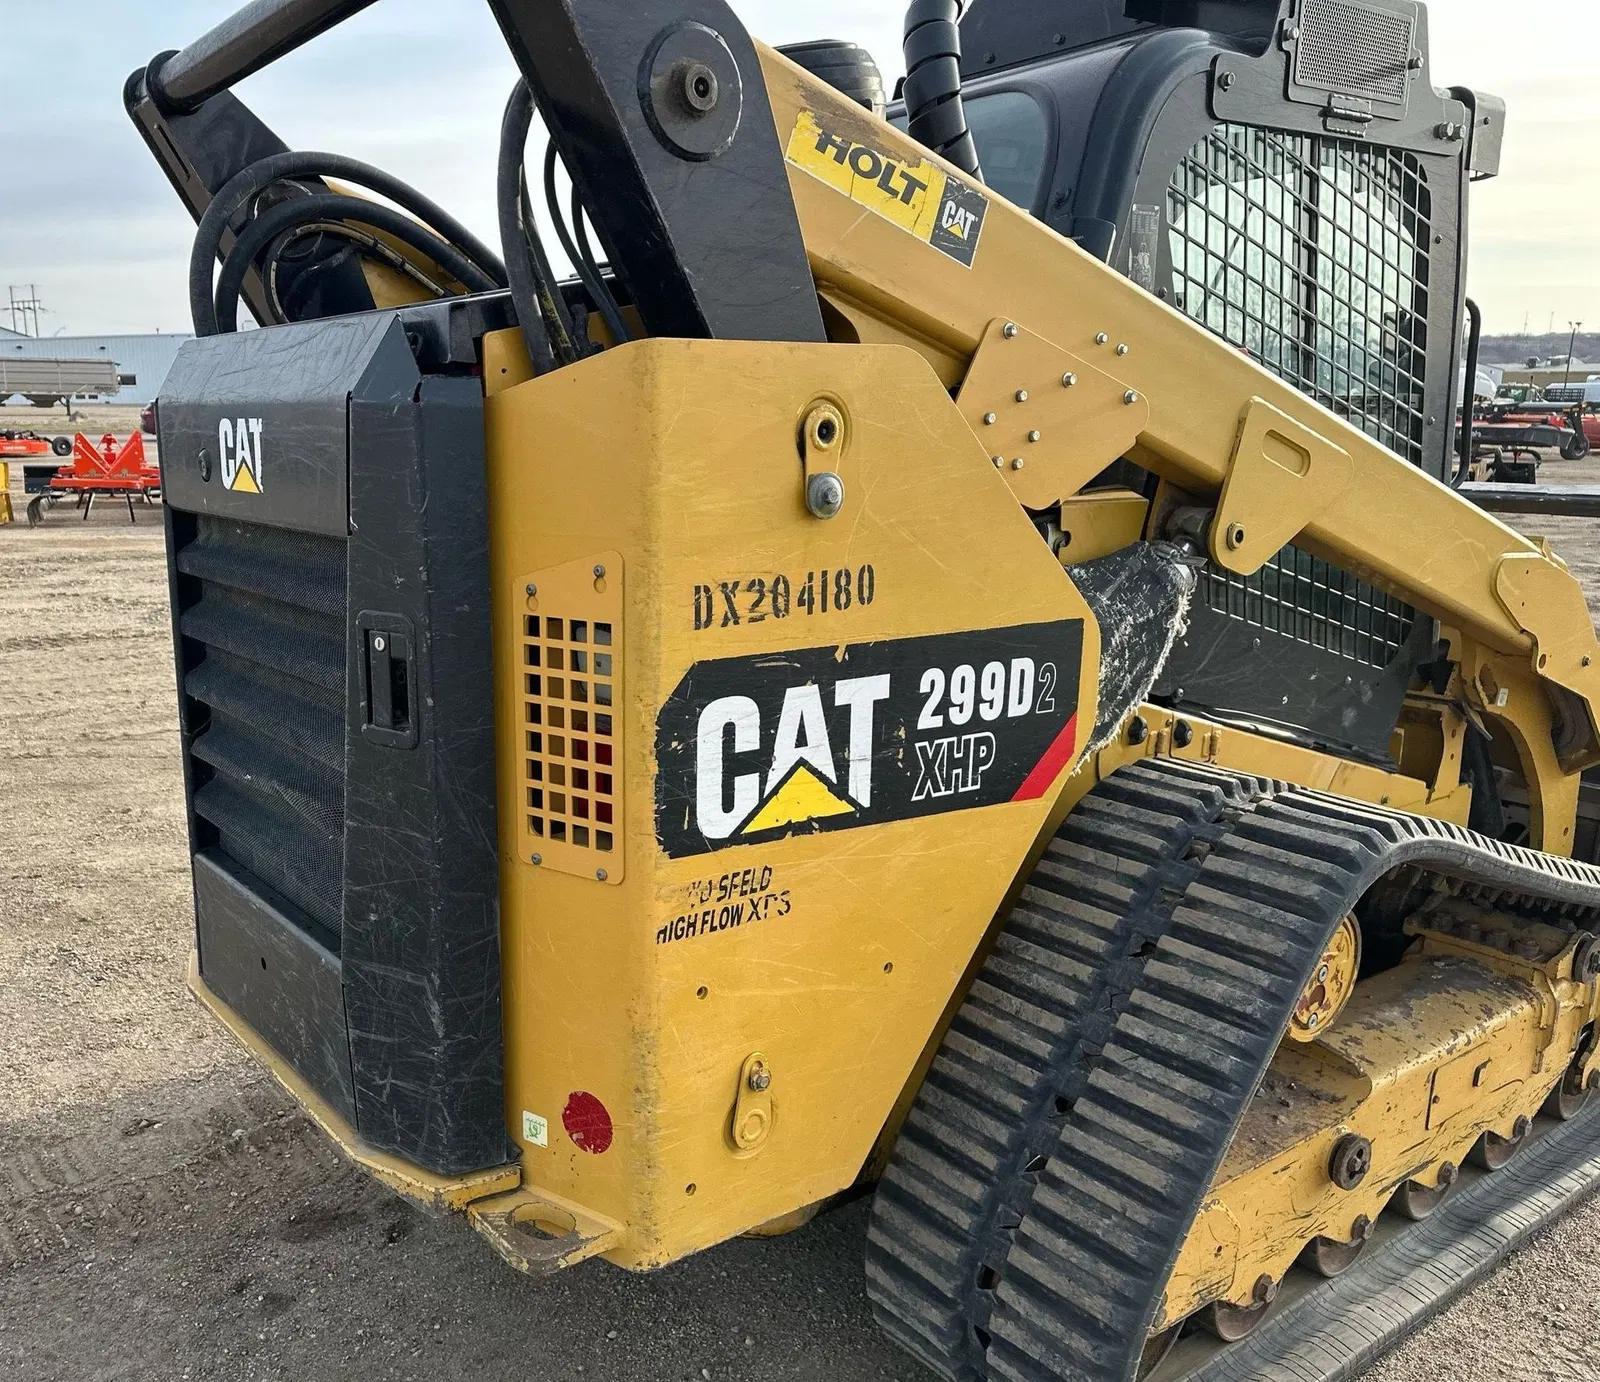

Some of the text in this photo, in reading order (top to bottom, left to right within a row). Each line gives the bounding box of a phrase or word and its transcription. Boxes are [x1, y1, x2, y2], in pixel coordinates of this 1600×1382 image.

[814, 129, 929, 206] HOLT
[941, 200, 978, 241] CAT
[218, 417, 264, 494] CAT
[694, 564, 875, 631] DX204180
[696, 673, 891, 840] CAT
[911, 731, 996, 802] XHP
[656, 912, 698, 945] HIGH
[700, 902, 745, 935] FLOW
